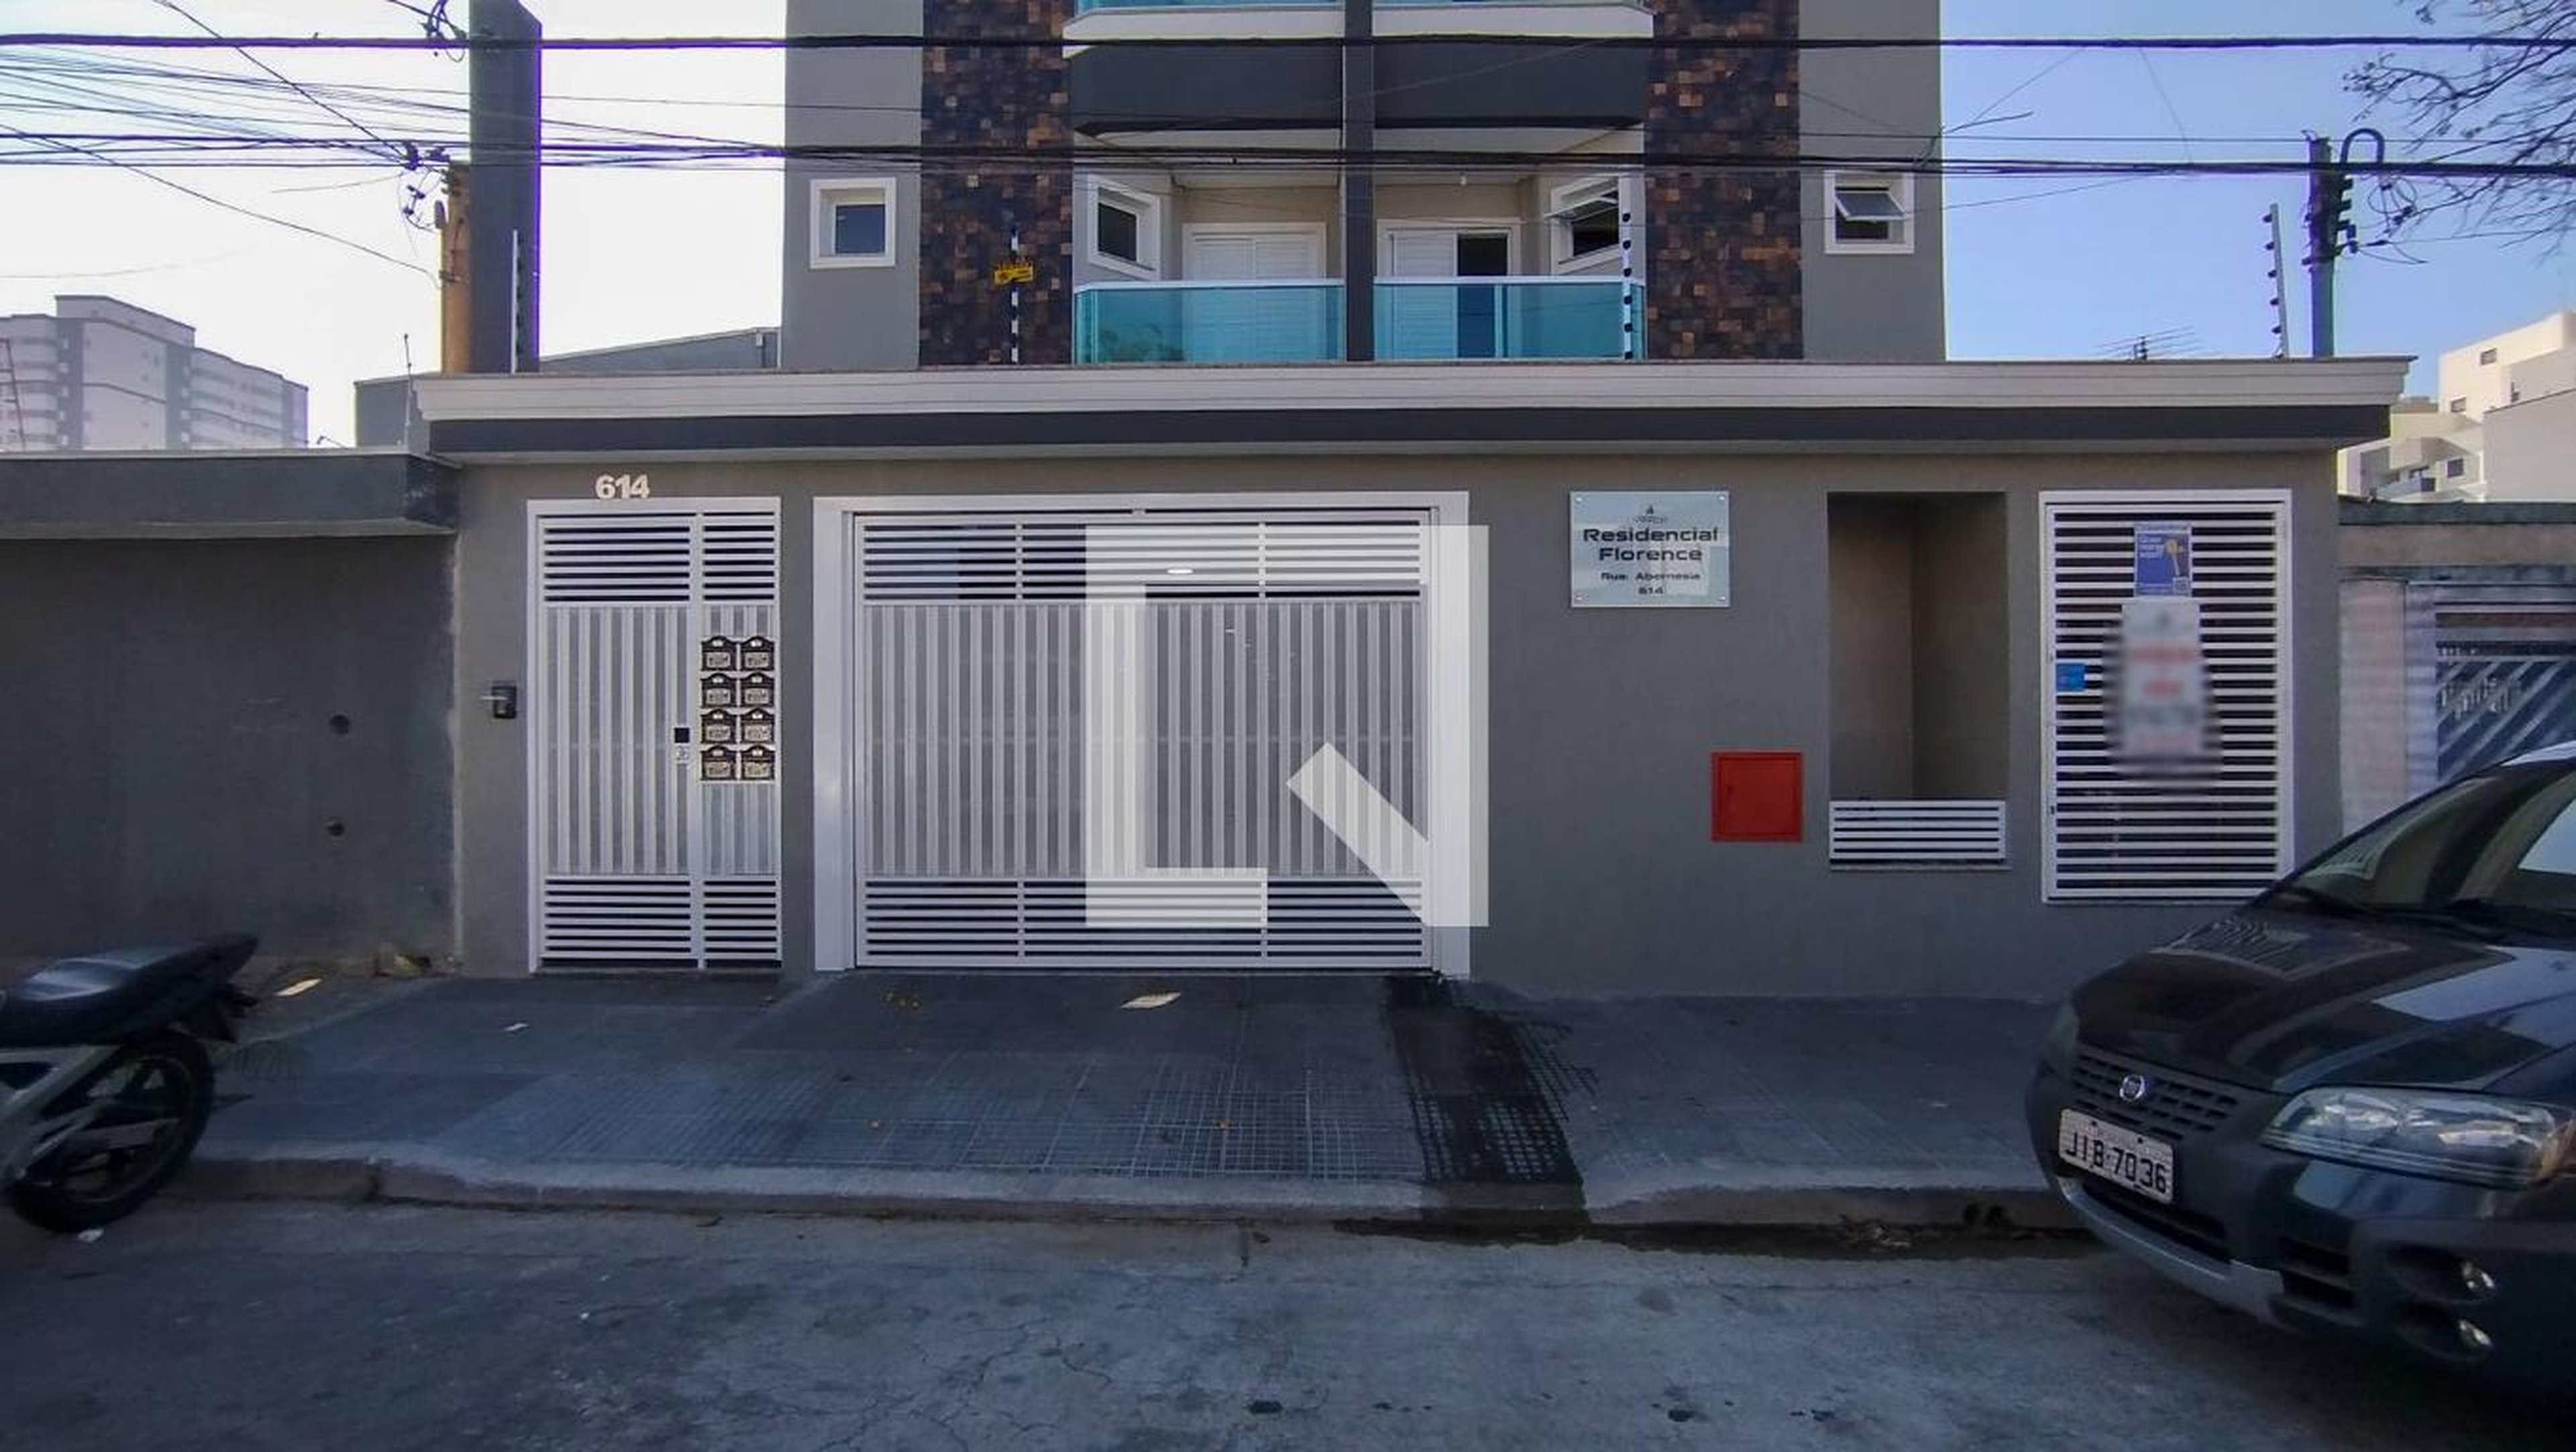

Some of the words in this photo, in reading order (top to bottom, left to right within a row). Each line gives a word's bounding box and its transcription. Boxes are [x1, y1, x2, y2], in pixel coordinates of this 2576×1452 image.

[595, 473, 650, 499] 614
[1583, 527, 1718, 542] Residencial
[1599, 547, 1703, 561] Florence
[1638, 586, 1664, 595] 614
